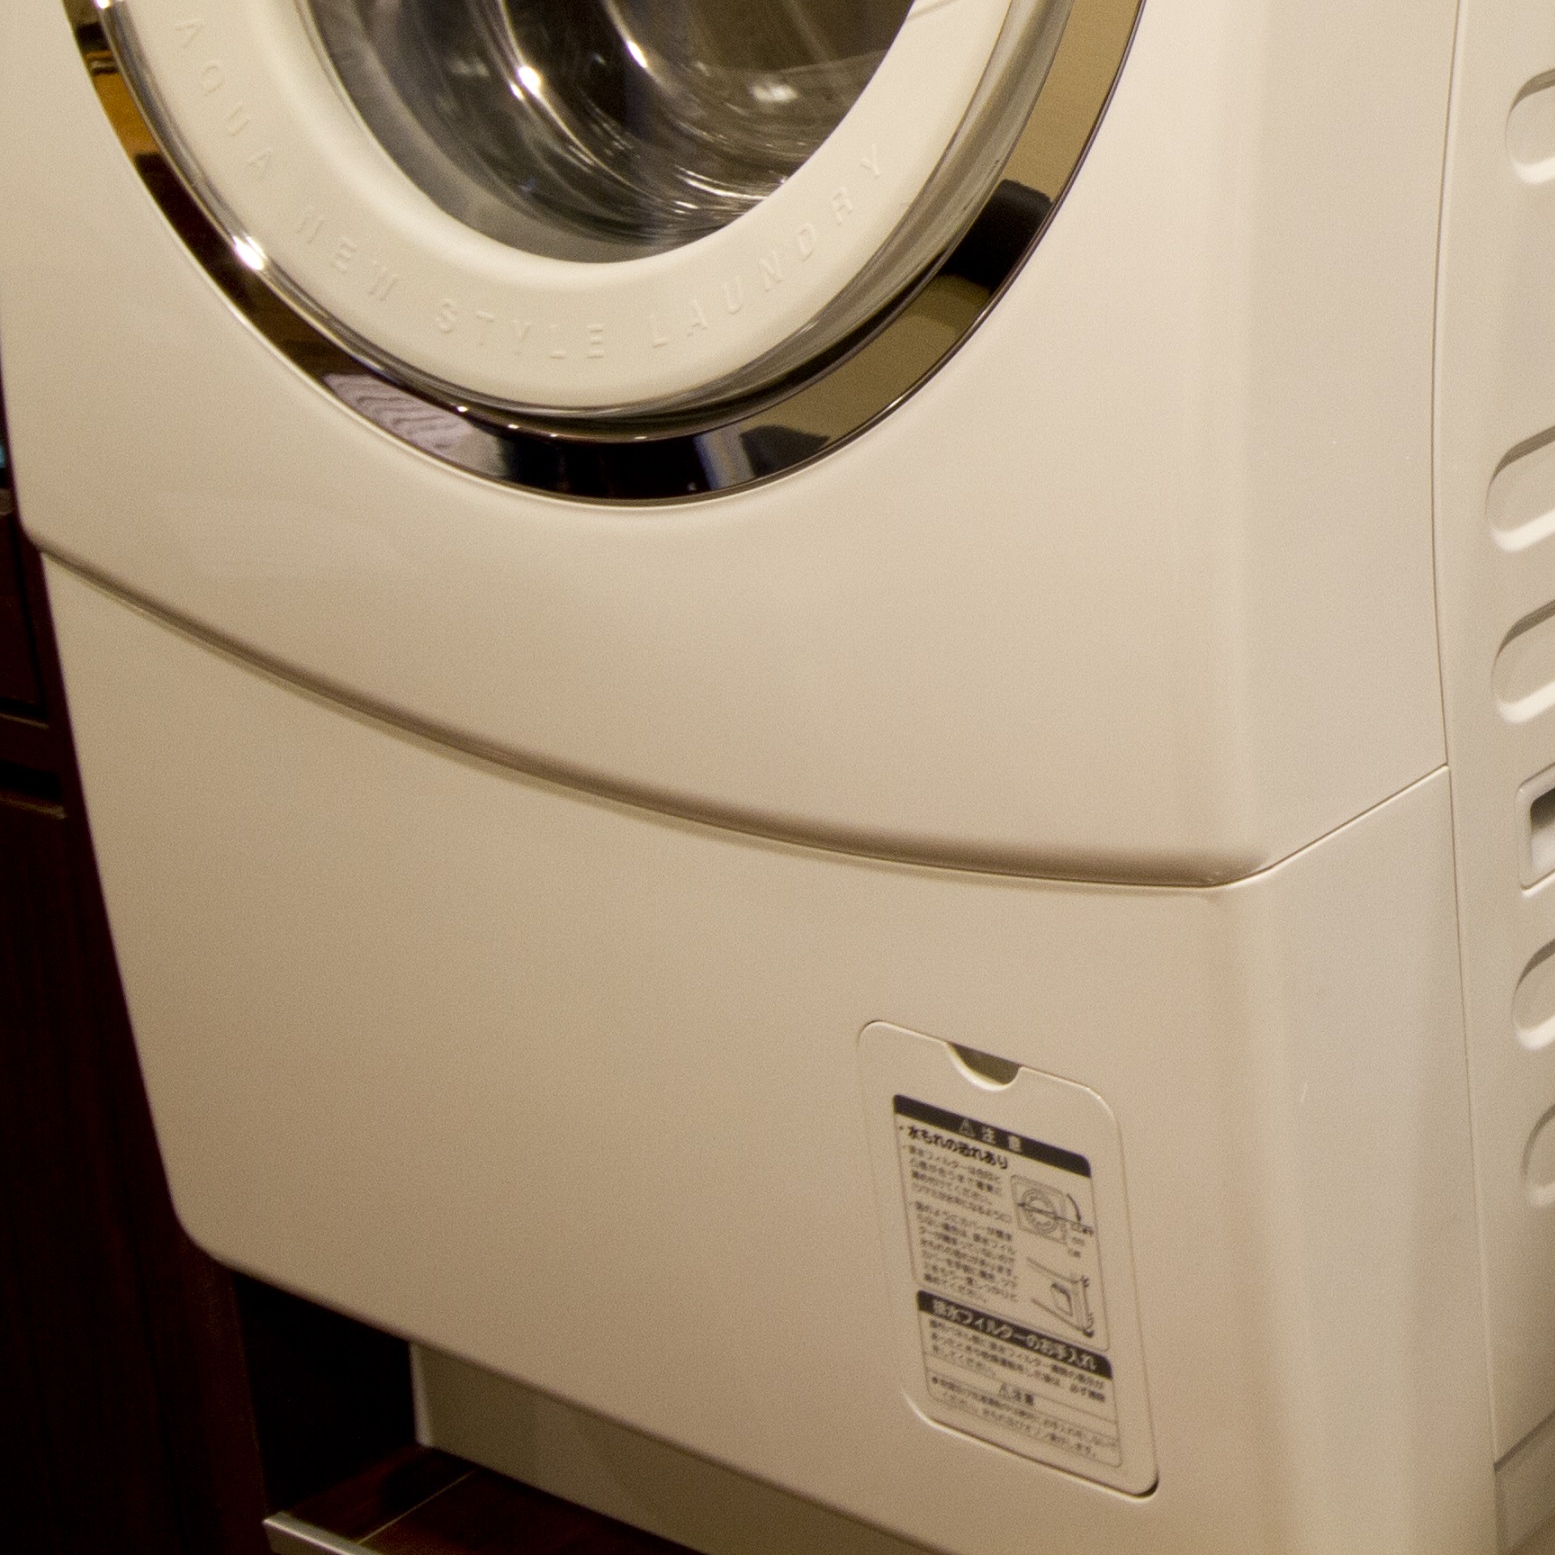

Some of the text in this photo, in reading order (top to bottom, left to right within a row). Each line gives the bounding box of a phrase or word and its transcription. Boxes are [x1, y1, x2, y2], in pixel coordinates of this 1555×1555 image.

[176, 15, 890, 360] AQUA NEW STYLE LAUNDRY
